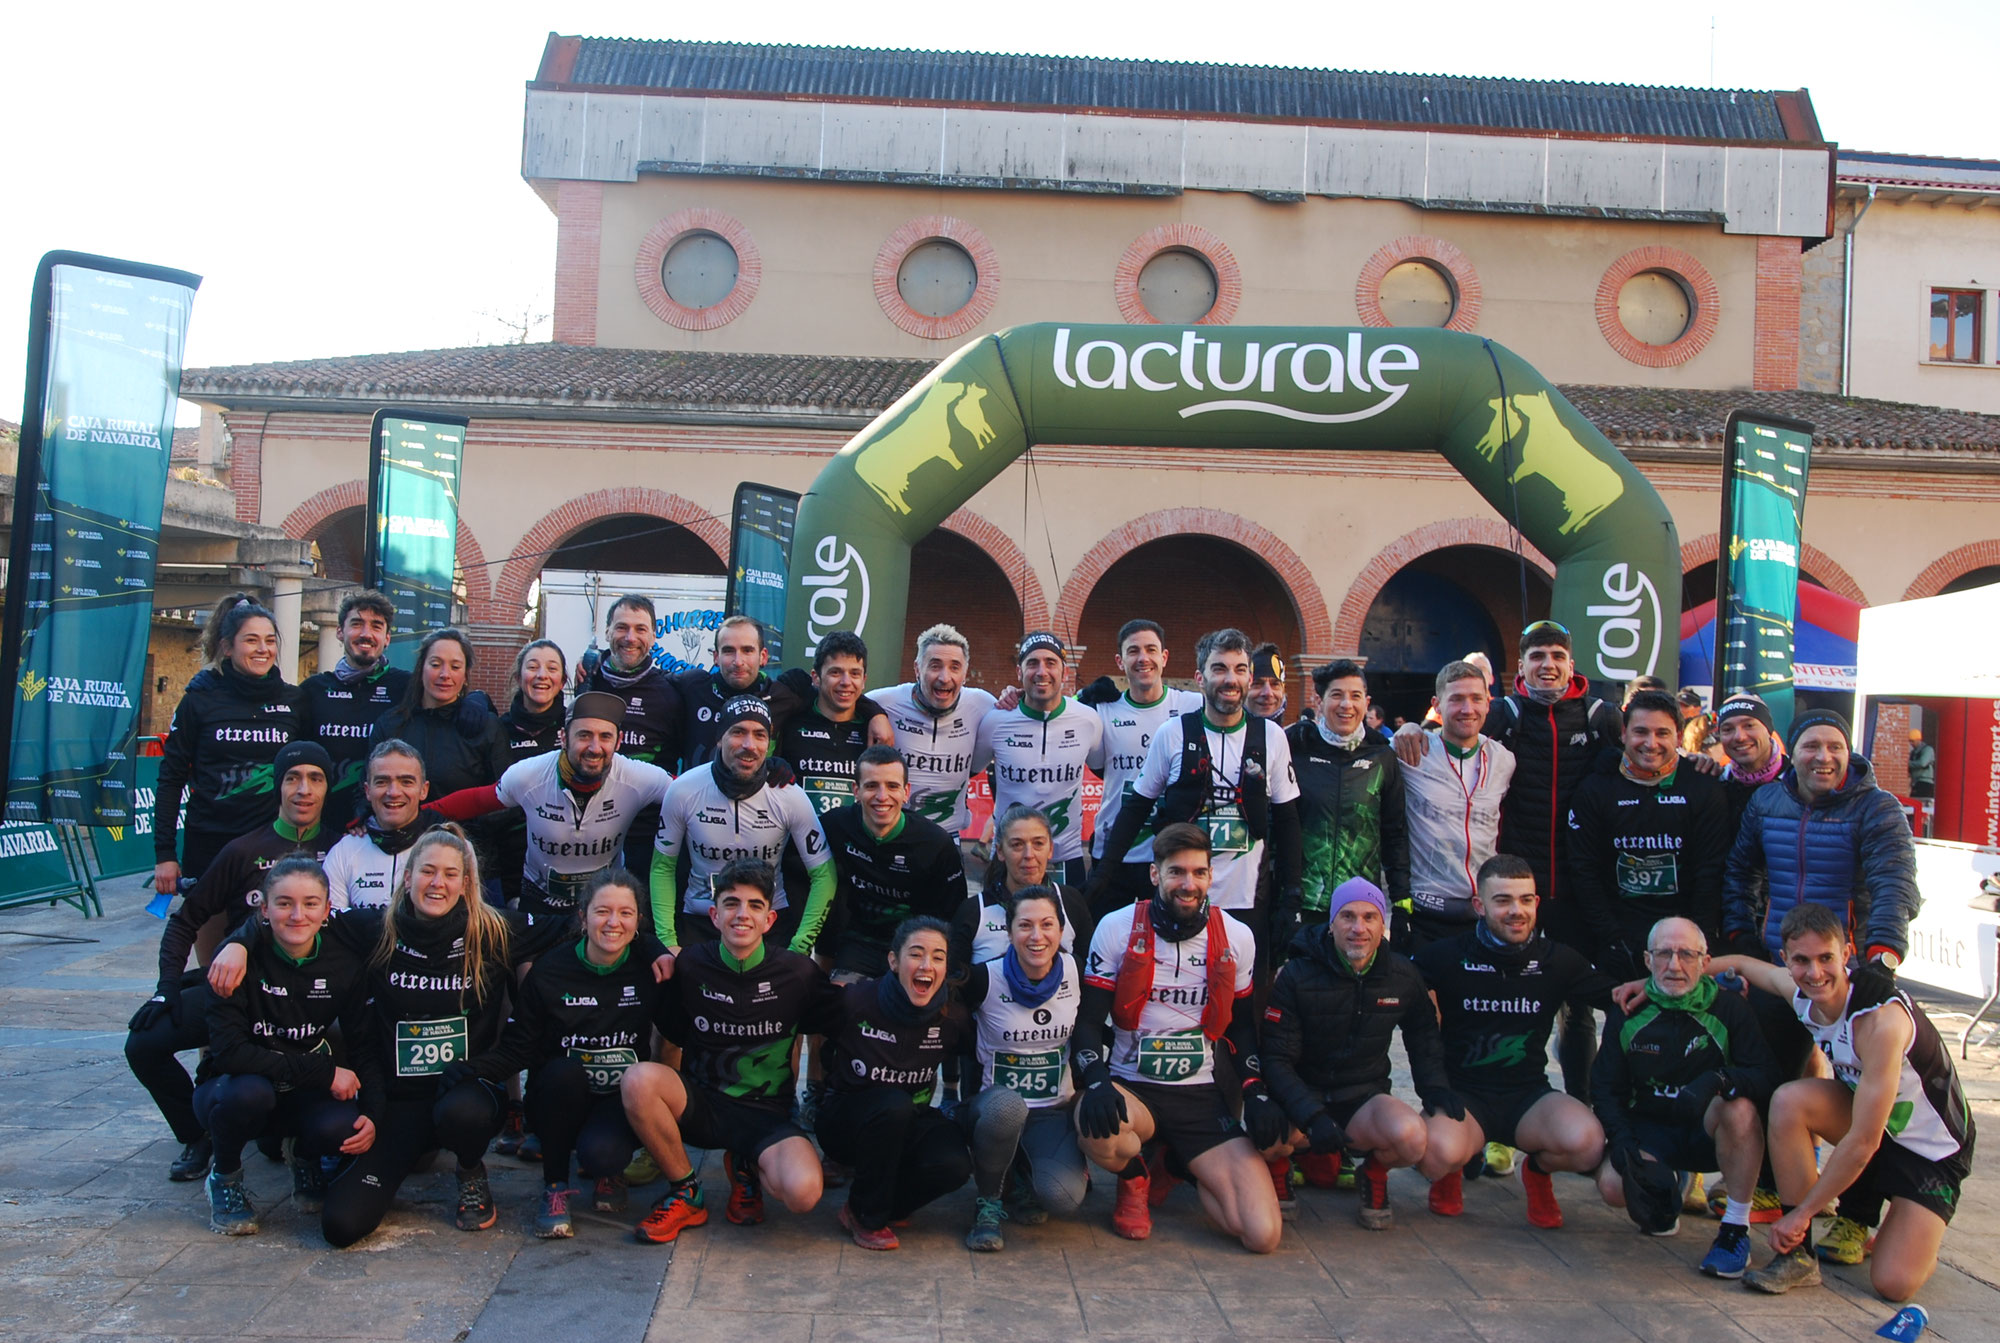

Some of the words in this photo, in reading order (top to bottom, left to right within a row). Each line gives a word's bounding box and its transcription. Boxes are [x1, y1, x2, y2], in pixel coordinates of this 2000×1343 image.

[1053, 328, 1420, 400] lacturale
[67, 415, 103, 430] CAJA
[107, 418, 158, 435] RURAL
[66, 428, 87, 442] DE
[90, 430, 162, 450] NAVARRA
[48, 677, 81, 691] CAJA
[84, 679, 126, 695] RURAL
[67, 691, 132, 708] NAVARRA
[216, 726, 289, 743] etxenike
[319, 722, 374, 738] etxeni
[801, 730, 831, 740] LUGA
[1658, 796, 1686, 804] LUGA
[539, 811, 565, 822] LUGA
[700, 816, 727, 825] LUGA
[1614, 833, 1683, 849] etxenike
[358, 880, 384, 888] LUGA
[1627, 870, 1663, 886] 397
[1464, 962, 1496, 972] LUGA
[390, 971, 473, 991] etxenike
[566, 996, 598, 1006] LUGA
[1463, 997, 1541, 1014] etxenike
[713, 1020, 783, 1037] etxenike
[861, 1026, 897, 1043] LUGA
[410, 1042, 454, 1065] 296
[1152, 1057, 1191, 1075] 178
[1005, 1072, 1047, 1091] 345
